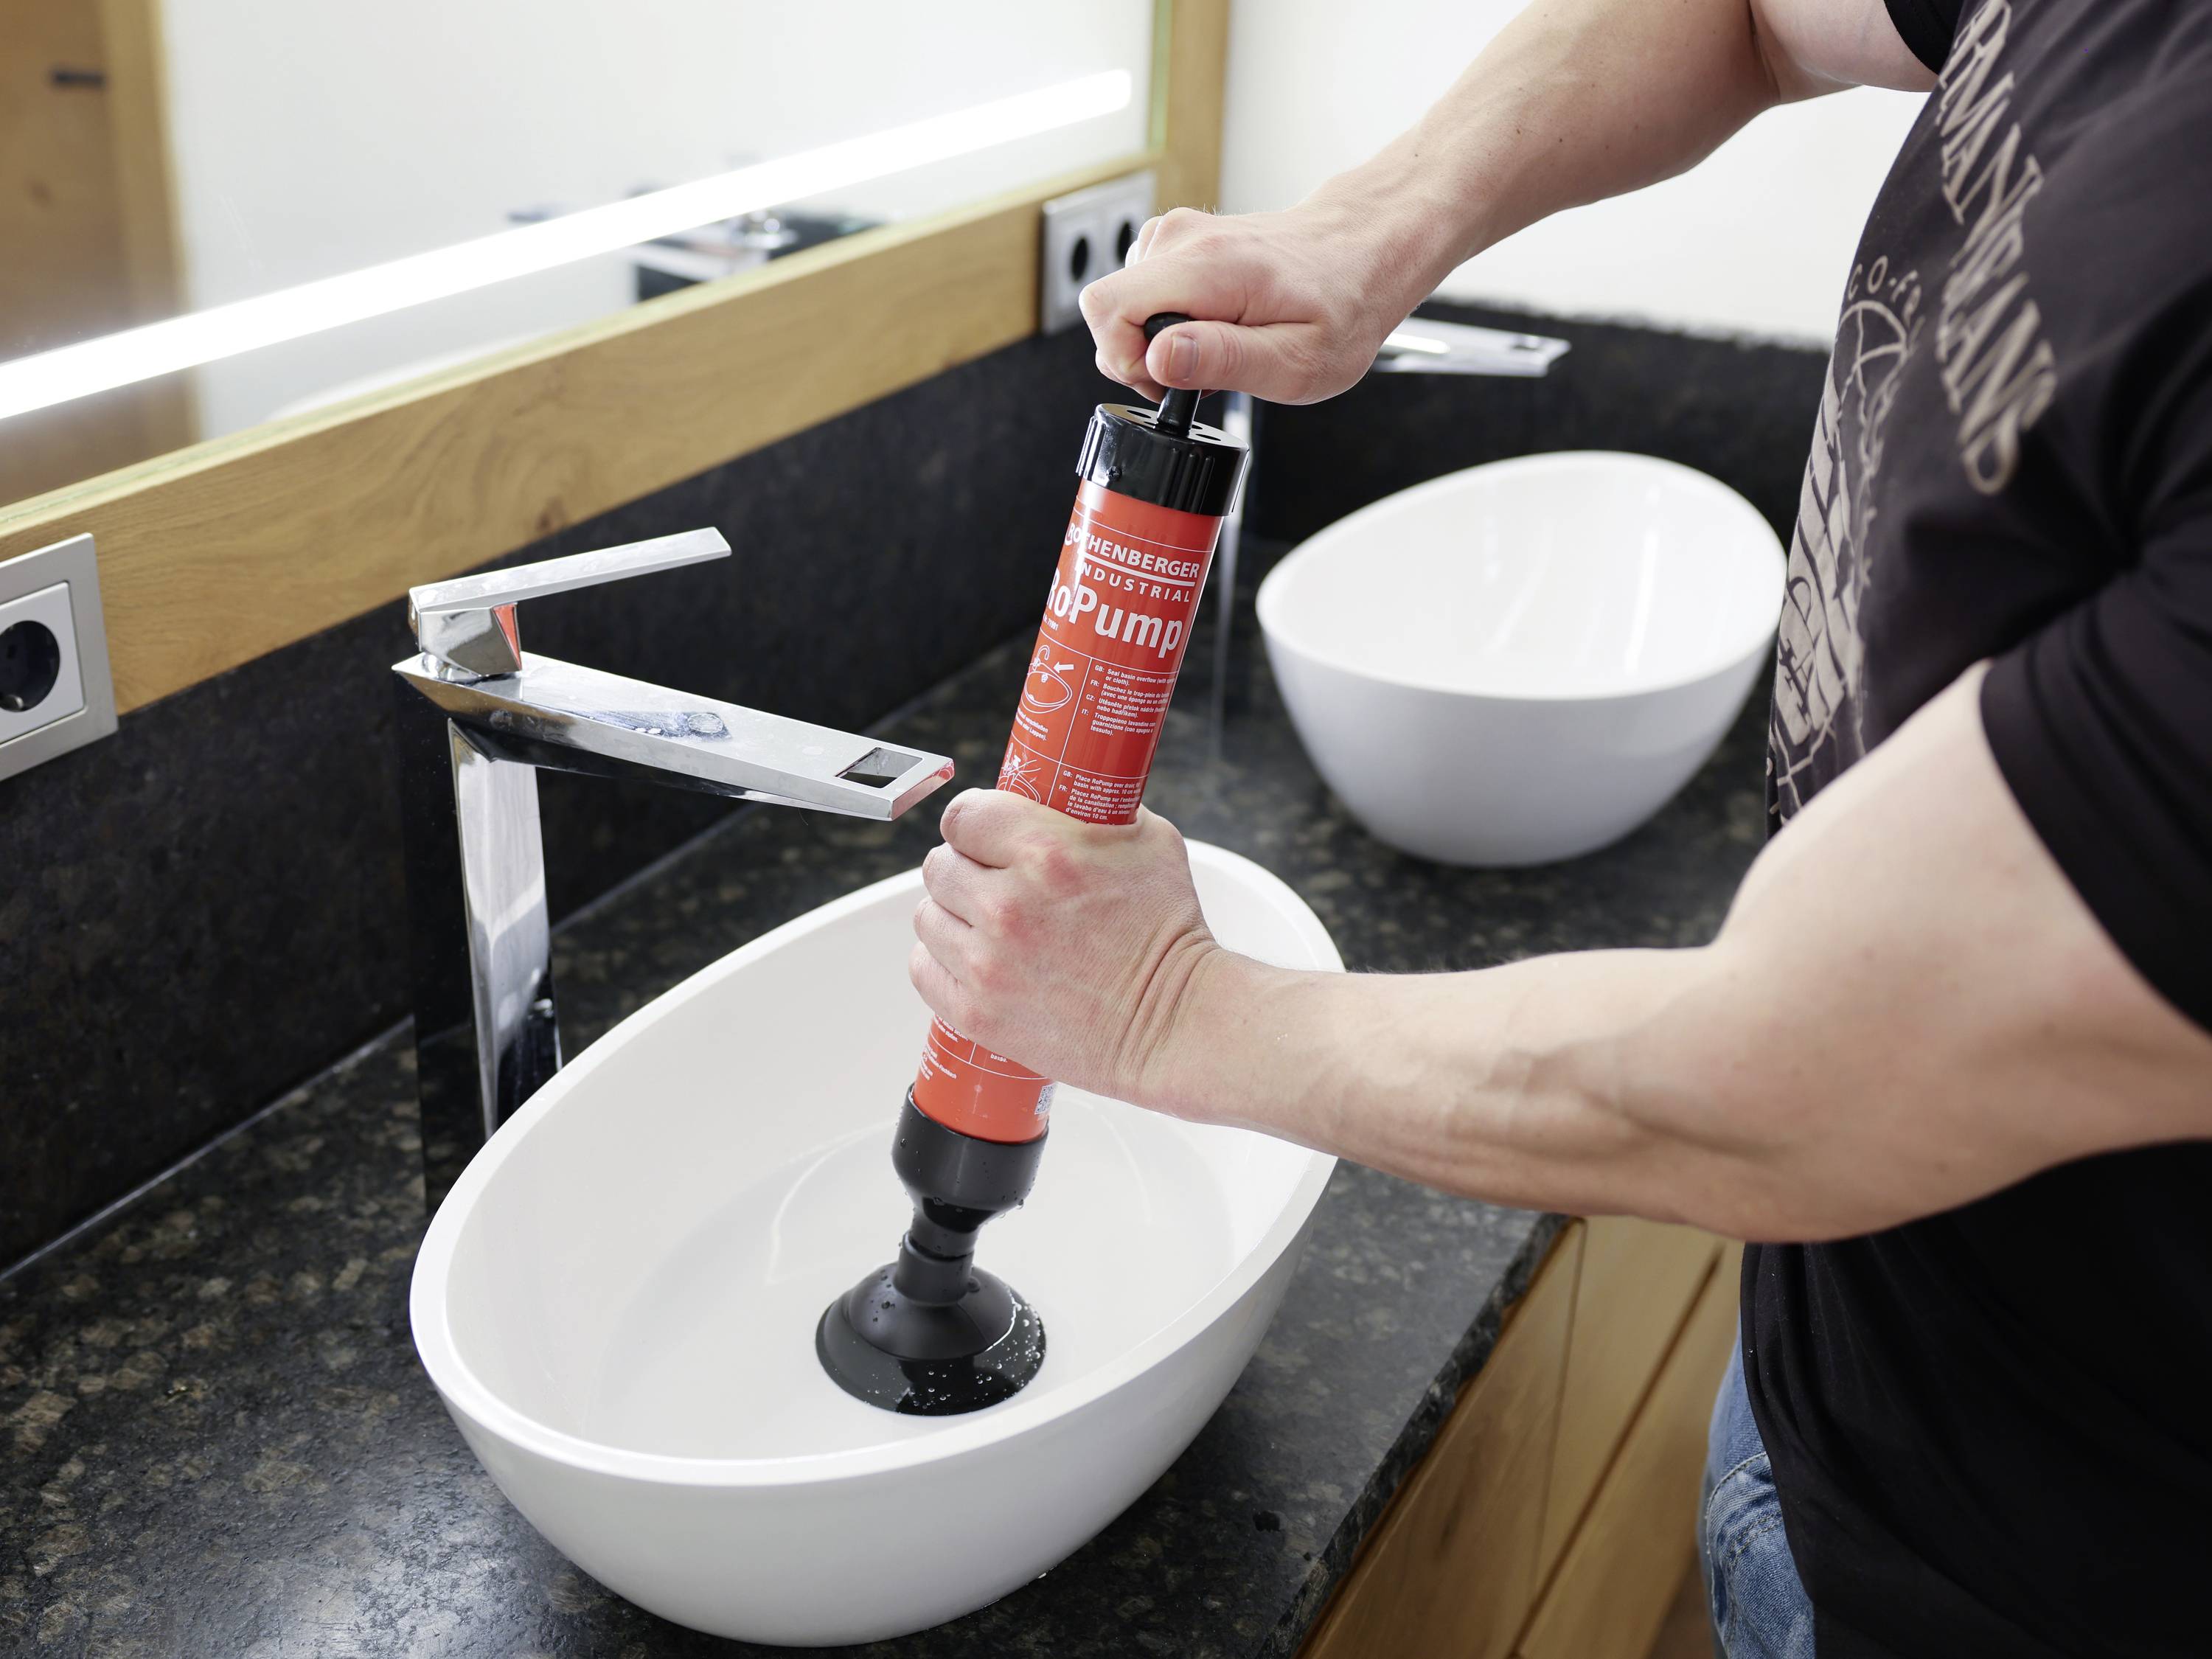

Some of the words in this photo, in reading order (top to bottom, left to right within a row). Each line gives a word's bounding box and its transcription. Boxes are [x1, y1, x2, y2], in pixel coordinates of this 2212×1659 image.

[1065, 522, 1200, 579] ROHENBERGER
[1075, 554, 1189, 602] NDUSTRIAL
[1107, 668, 1119, 677] Seal
[1121, 672, 1135, 680] basin
[1136, 675, 1156, 684] overflow
[1103, 684, 1126, 693] Bouchez
[1062, 770, 1073, 778] GB:
[1076, 773, 1091, 782] Place
[1091, 778, 1113, 787] RoPump
[1073, 781, 1088, 789] basin
[1059, 784, 1068, 792] FR:
[1071, 788, 1089, 797] Placez
[1090, 793, 1111, 802] RoPump
[1065, 807, 1091, 818] d'environ
[1074, 802, 1092, 811] lavabo
